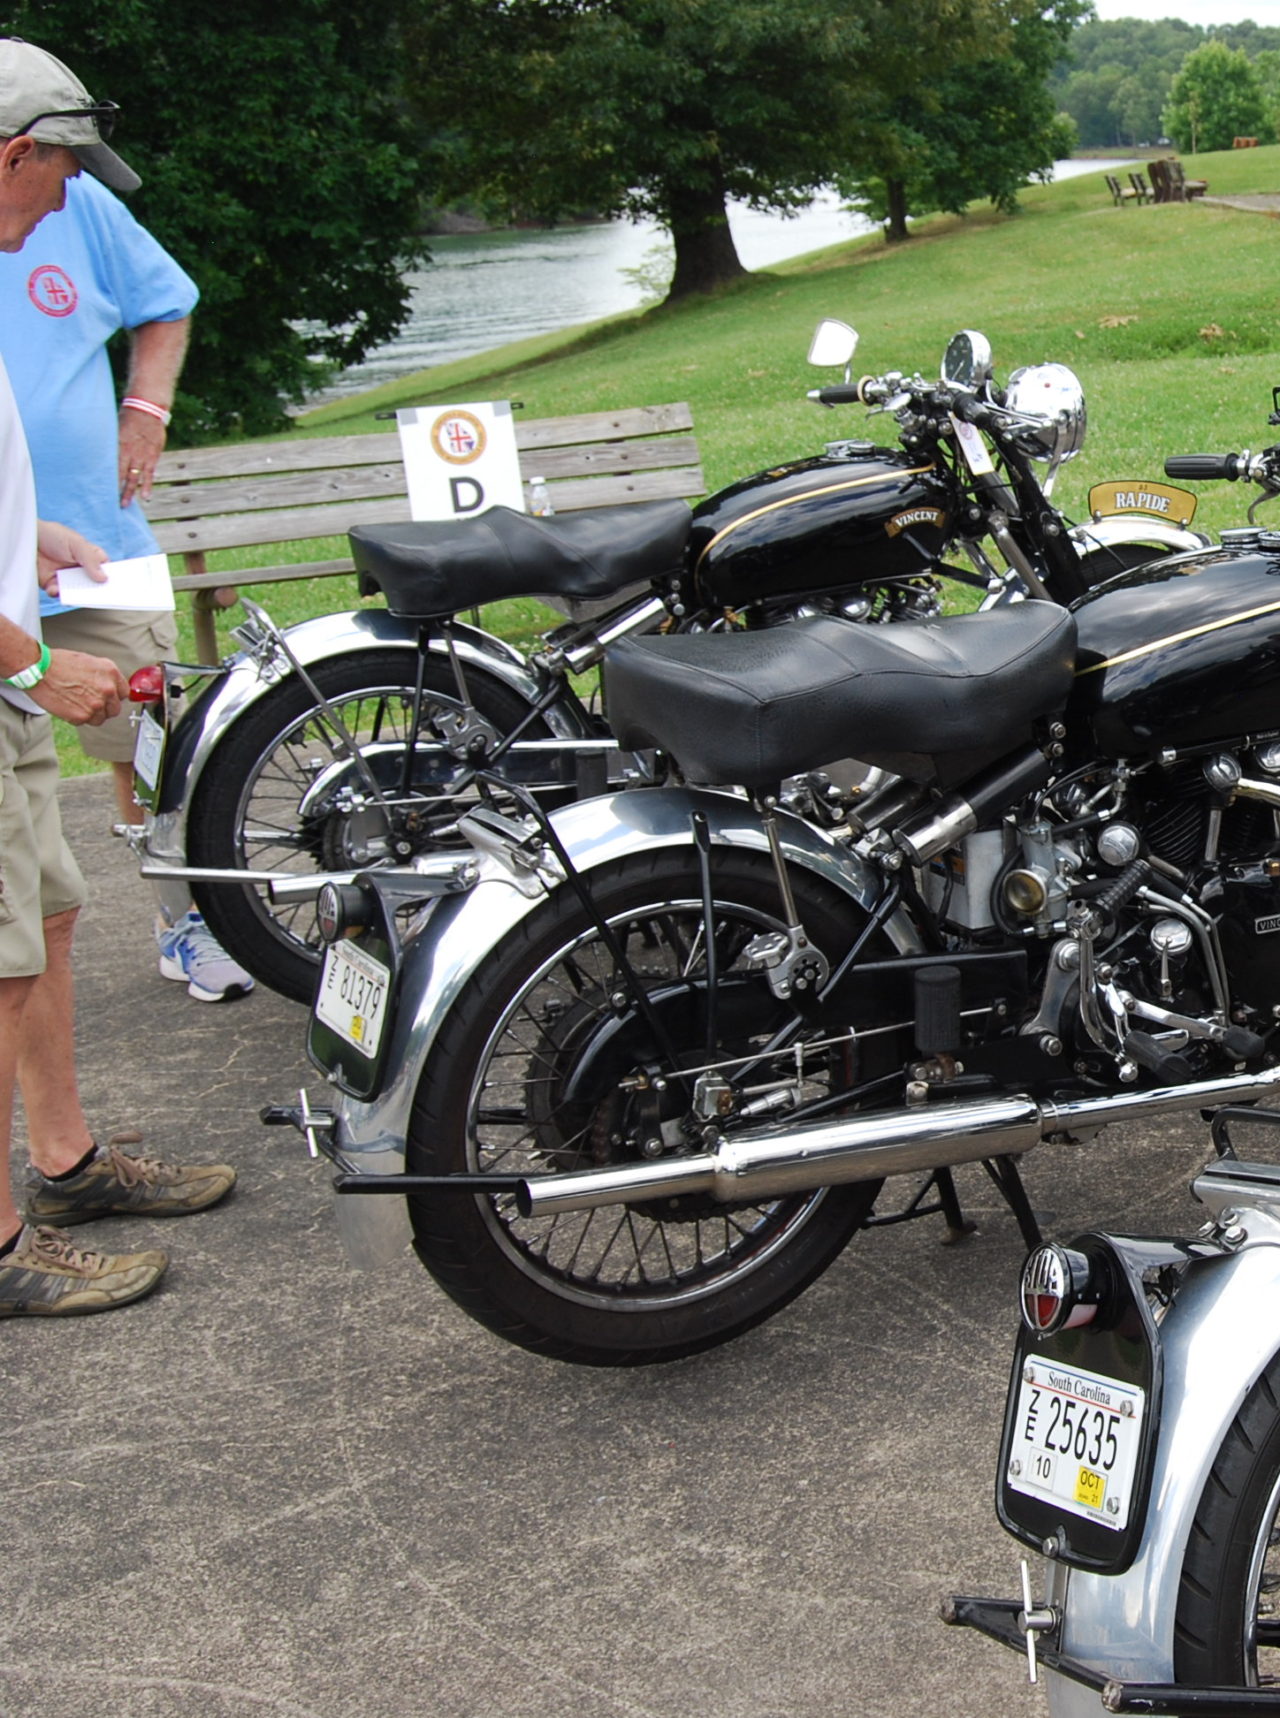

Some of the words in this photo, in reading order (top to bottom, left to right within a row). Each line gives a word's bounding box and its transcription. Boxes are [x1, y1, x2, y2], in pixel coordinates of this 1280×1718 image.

[449, 476, 484, 513] D
[1115, 492, 1170, 512] RAPIDE
[895, 511, 938, 528] VINCENT
[340, 966, 382, 1020] 81379
[1048, 1371, 1072, 1393] South
[1074, 1379, 1111, 1405] Carolina
[1044, 1396, 1120, 1471] 25635
[1036, 1455, 1051, 1479] 10
[1080, 1470, 1101, 1489] OCT
